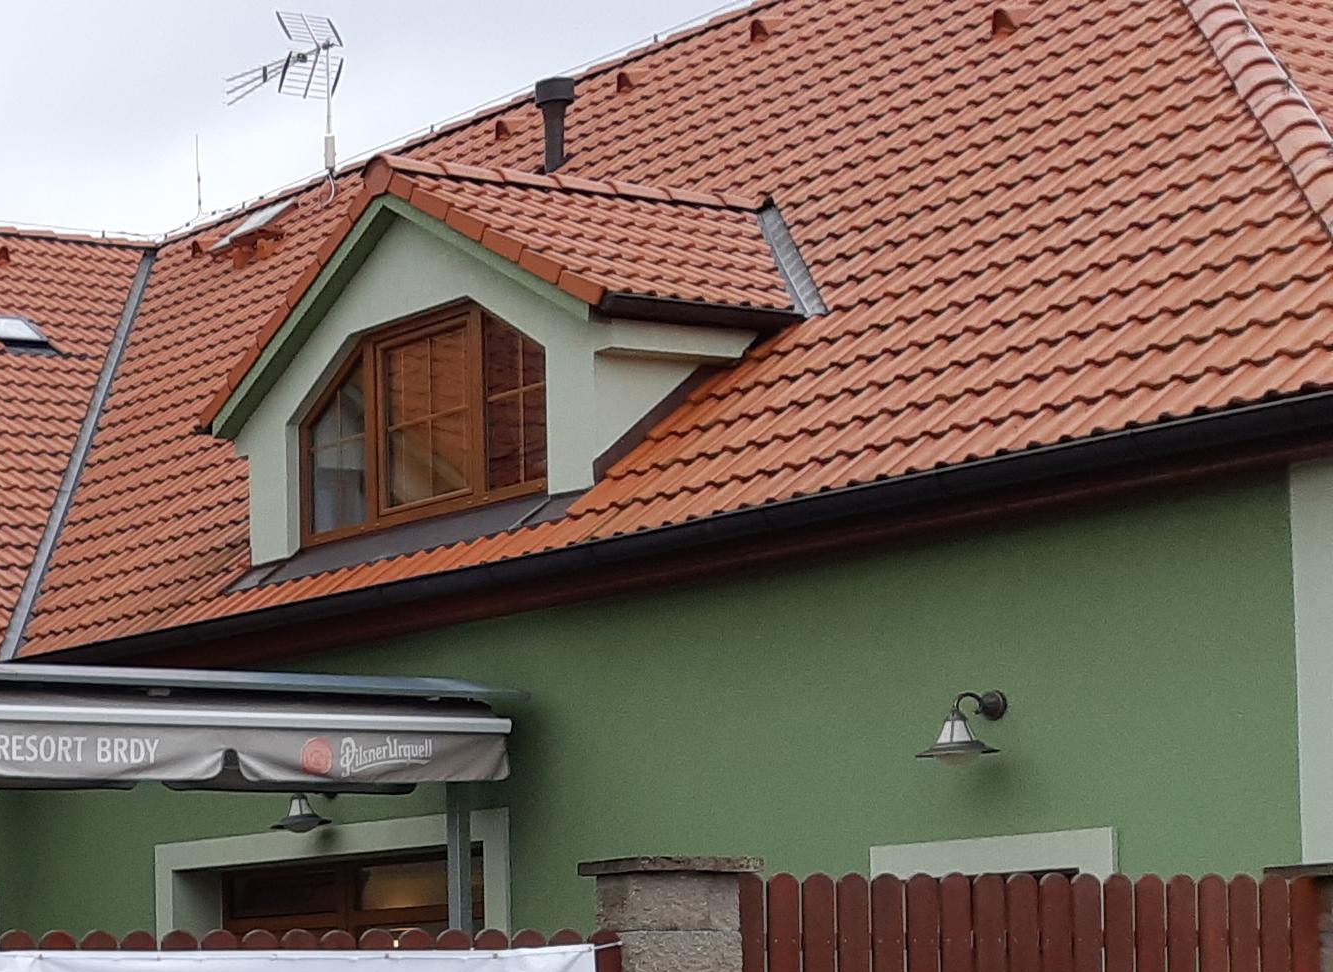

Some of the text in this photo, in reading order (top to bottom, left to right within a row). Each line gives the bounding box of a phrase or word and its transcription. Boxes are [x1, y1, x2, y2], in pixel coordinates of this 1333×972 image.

[96, 737, 160, 764] BRDY
[340, 736, 433, 778] Pilsner Urquell
